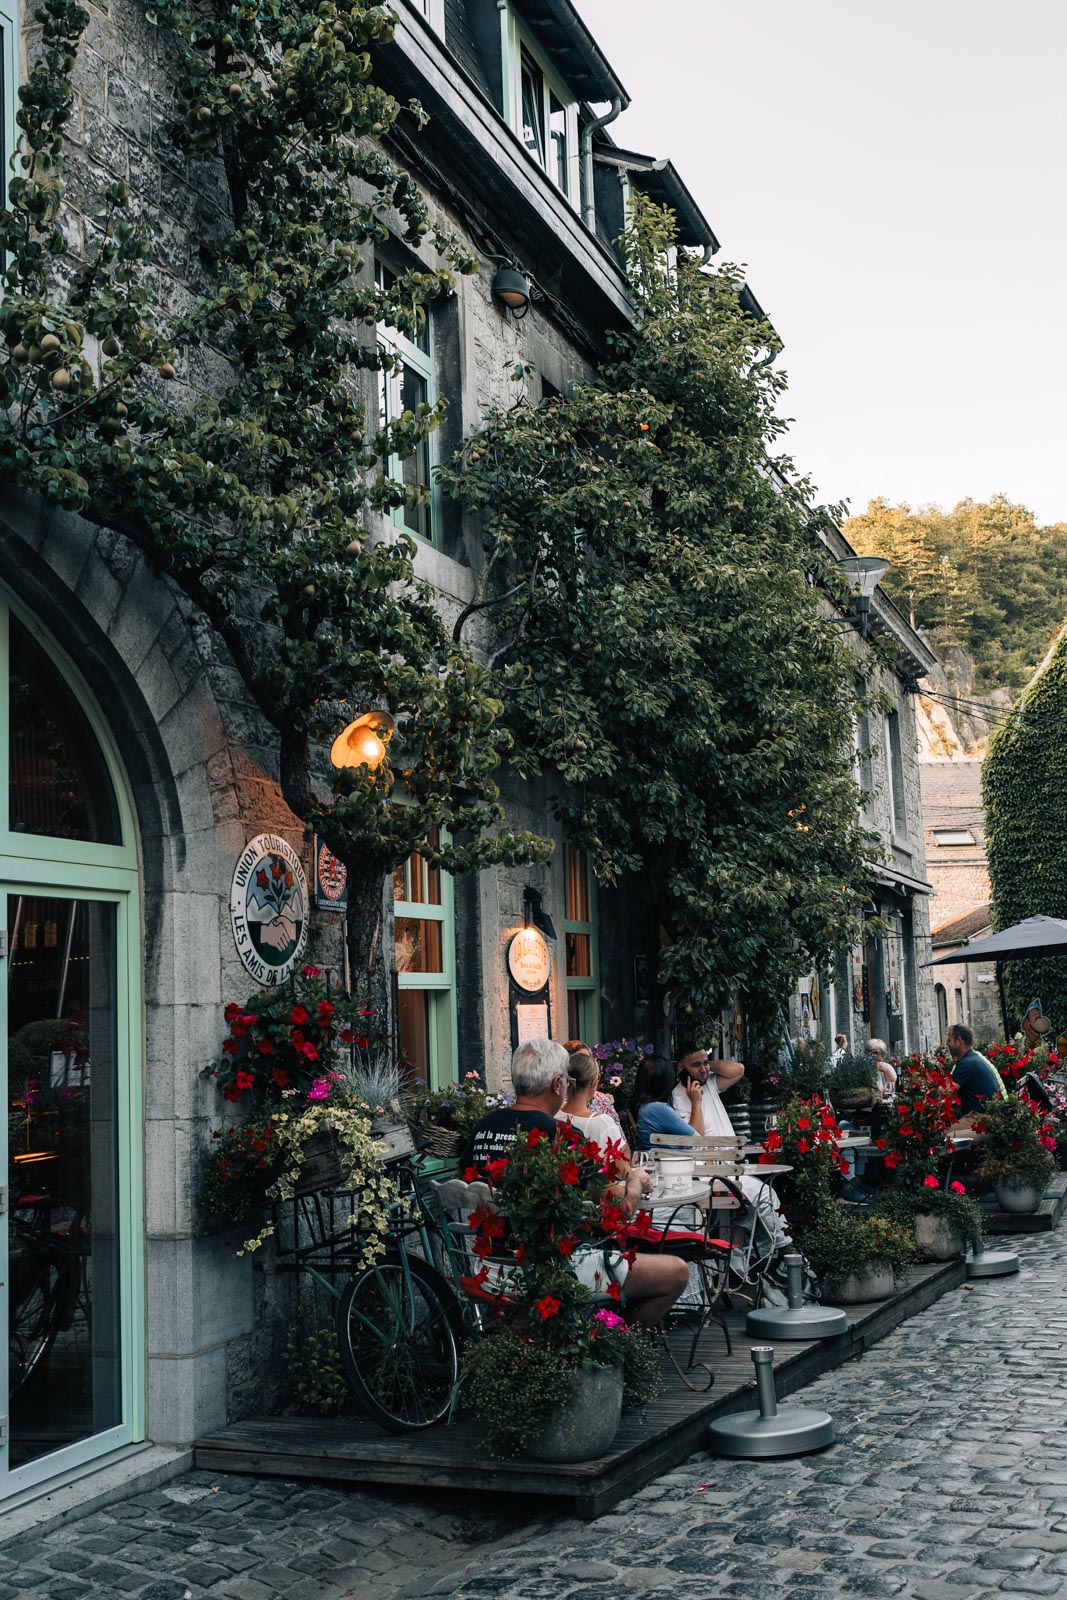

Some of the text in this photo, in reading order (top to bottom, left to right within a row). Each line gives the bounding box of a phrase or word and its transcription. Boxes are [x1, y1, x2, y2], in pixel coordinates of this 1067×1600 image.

[236, 836, 305, 889] UNION TOURISTIQUE
[233, 915, 247, 946] LES
[243, 949, 266, 980] AMIS
[281, 964, 292, 981] LA
